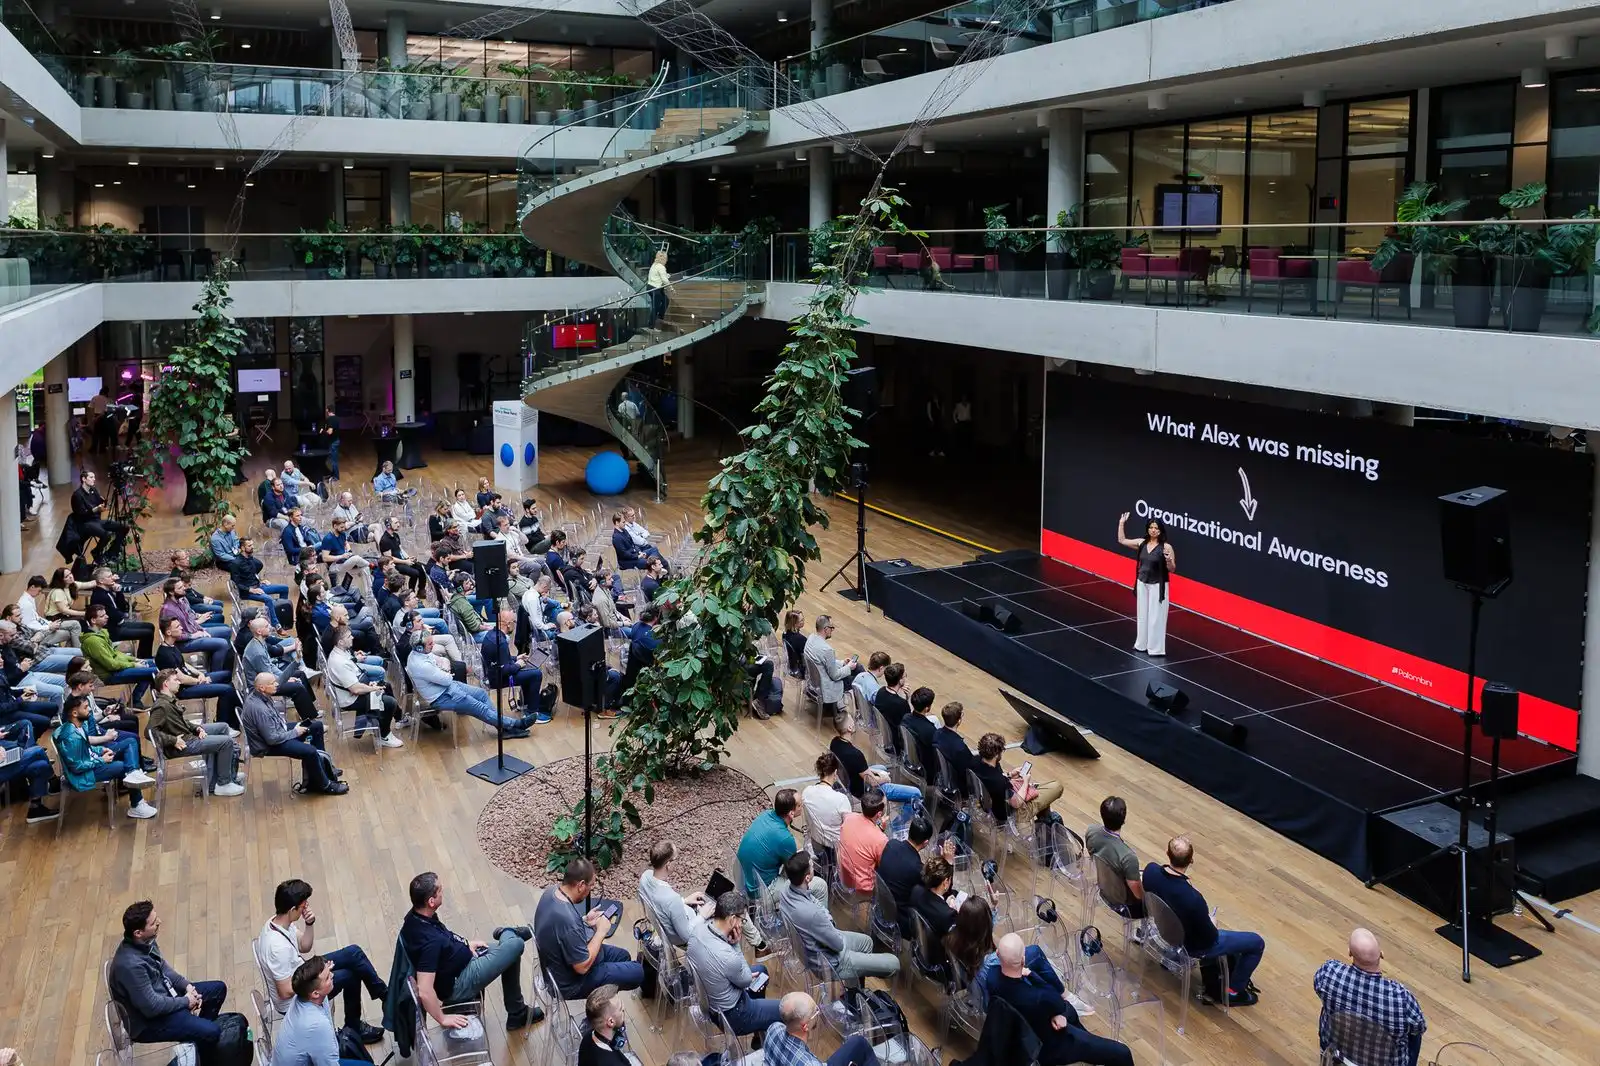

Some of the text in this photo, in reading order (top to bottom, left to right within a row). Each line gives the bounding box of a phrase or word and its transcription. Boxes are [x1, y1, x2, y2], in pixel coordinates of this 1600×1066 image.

[1147, 412, 1380, 481] What Alex was missing
[1135, 499, 1389, 588] Organizational Awareness
